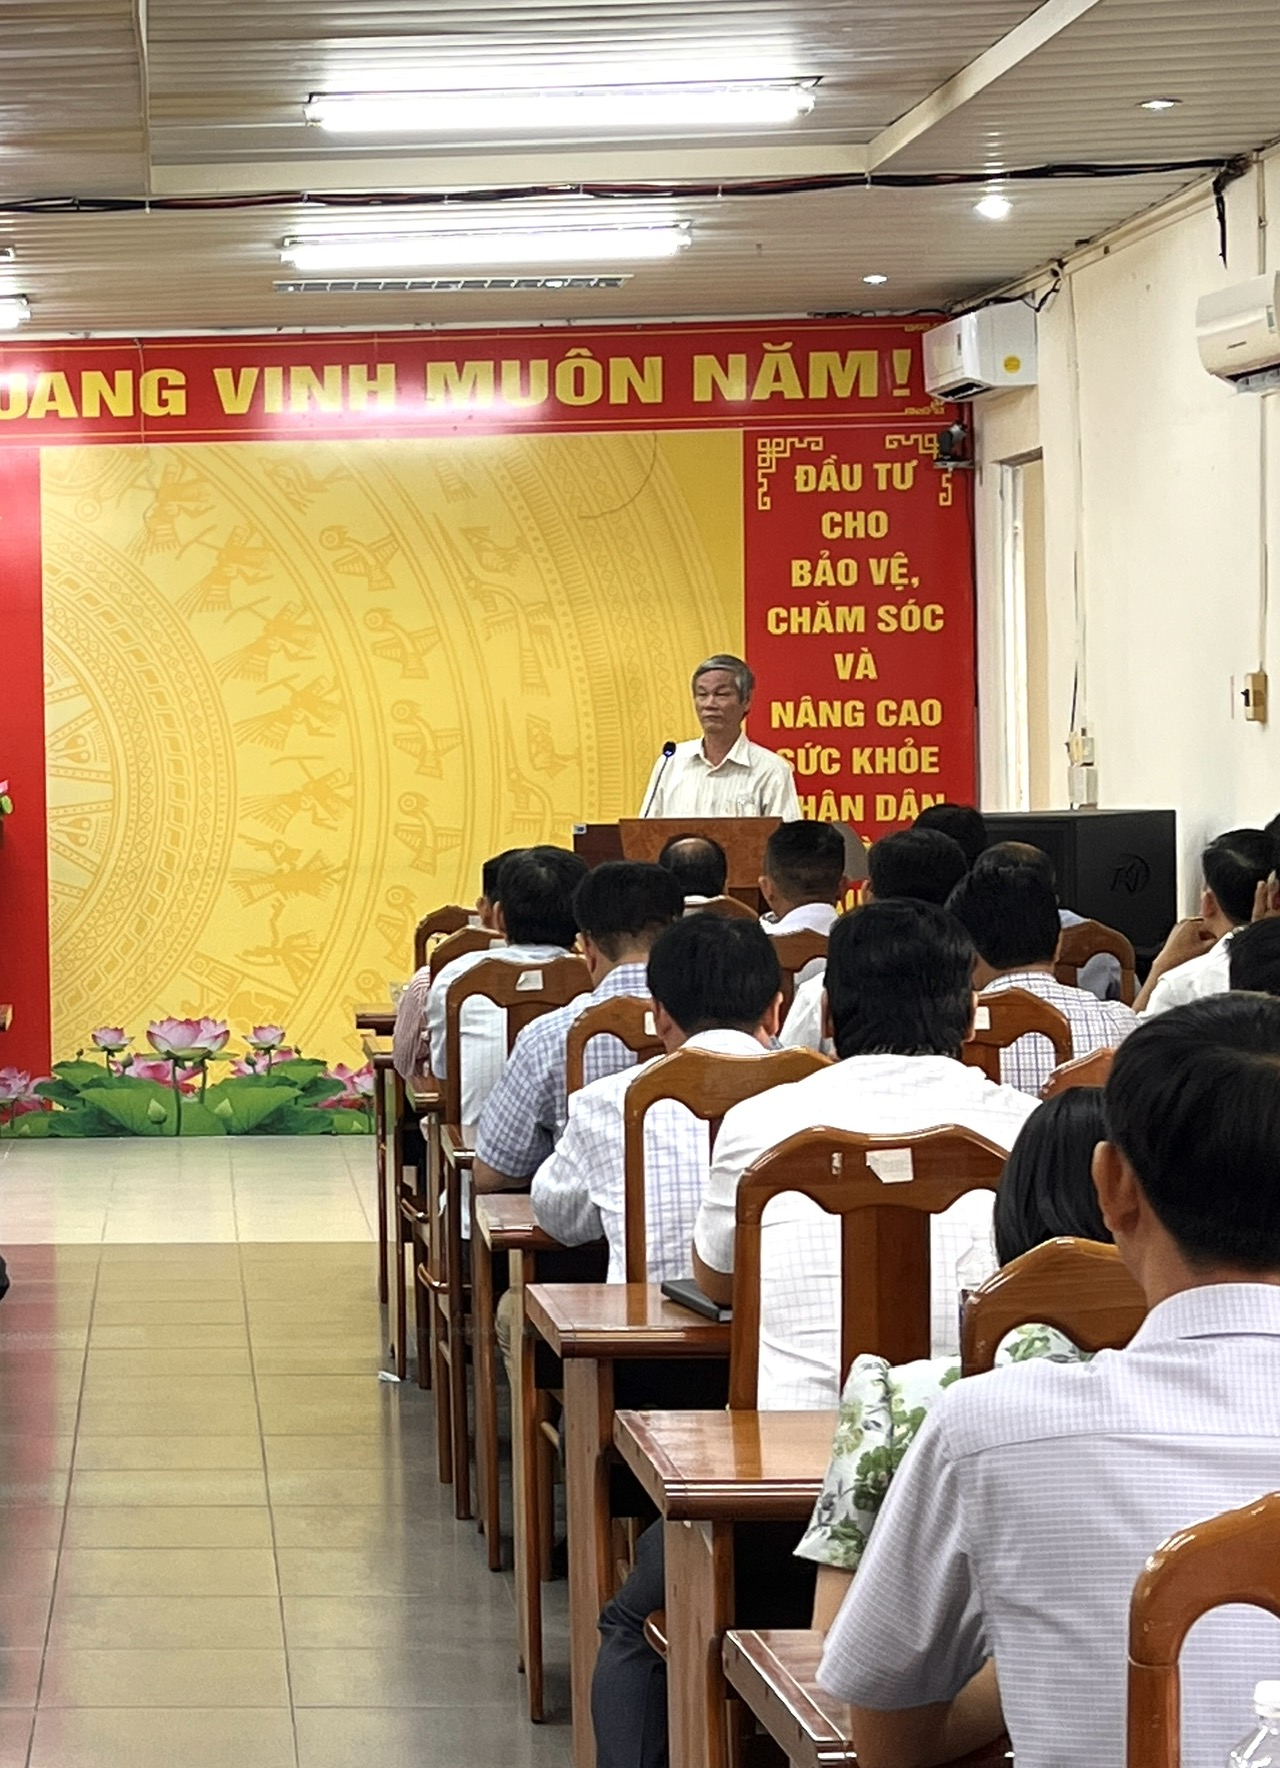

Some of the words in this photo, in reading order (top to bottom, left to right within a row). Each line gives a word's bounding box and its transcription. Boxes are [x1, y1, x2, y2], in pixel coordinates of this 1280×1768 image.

[213, 363, 395, 415] VINH
[426, 347, 664, 406] MUÔN
[794, 455, 862, 492] ĐẦU
[874, 459, 918, 491] TƯ
[821, 511, 888, 539] CHO
[791, 551, 858, 587] BẢO
[869, 552, 920, 591] VỆ,
[767, 601, 865, 634] CHĂM
[878, 599, 944, 633] SÓC
[834, 648, 878, 680] VÀ
[771, 696, 865, 728] NÂNG
[876, 698, 942, 727] CAO
[852, 738, 939, 775] KHỎE
[799, 789, 864, 822] HÂN
